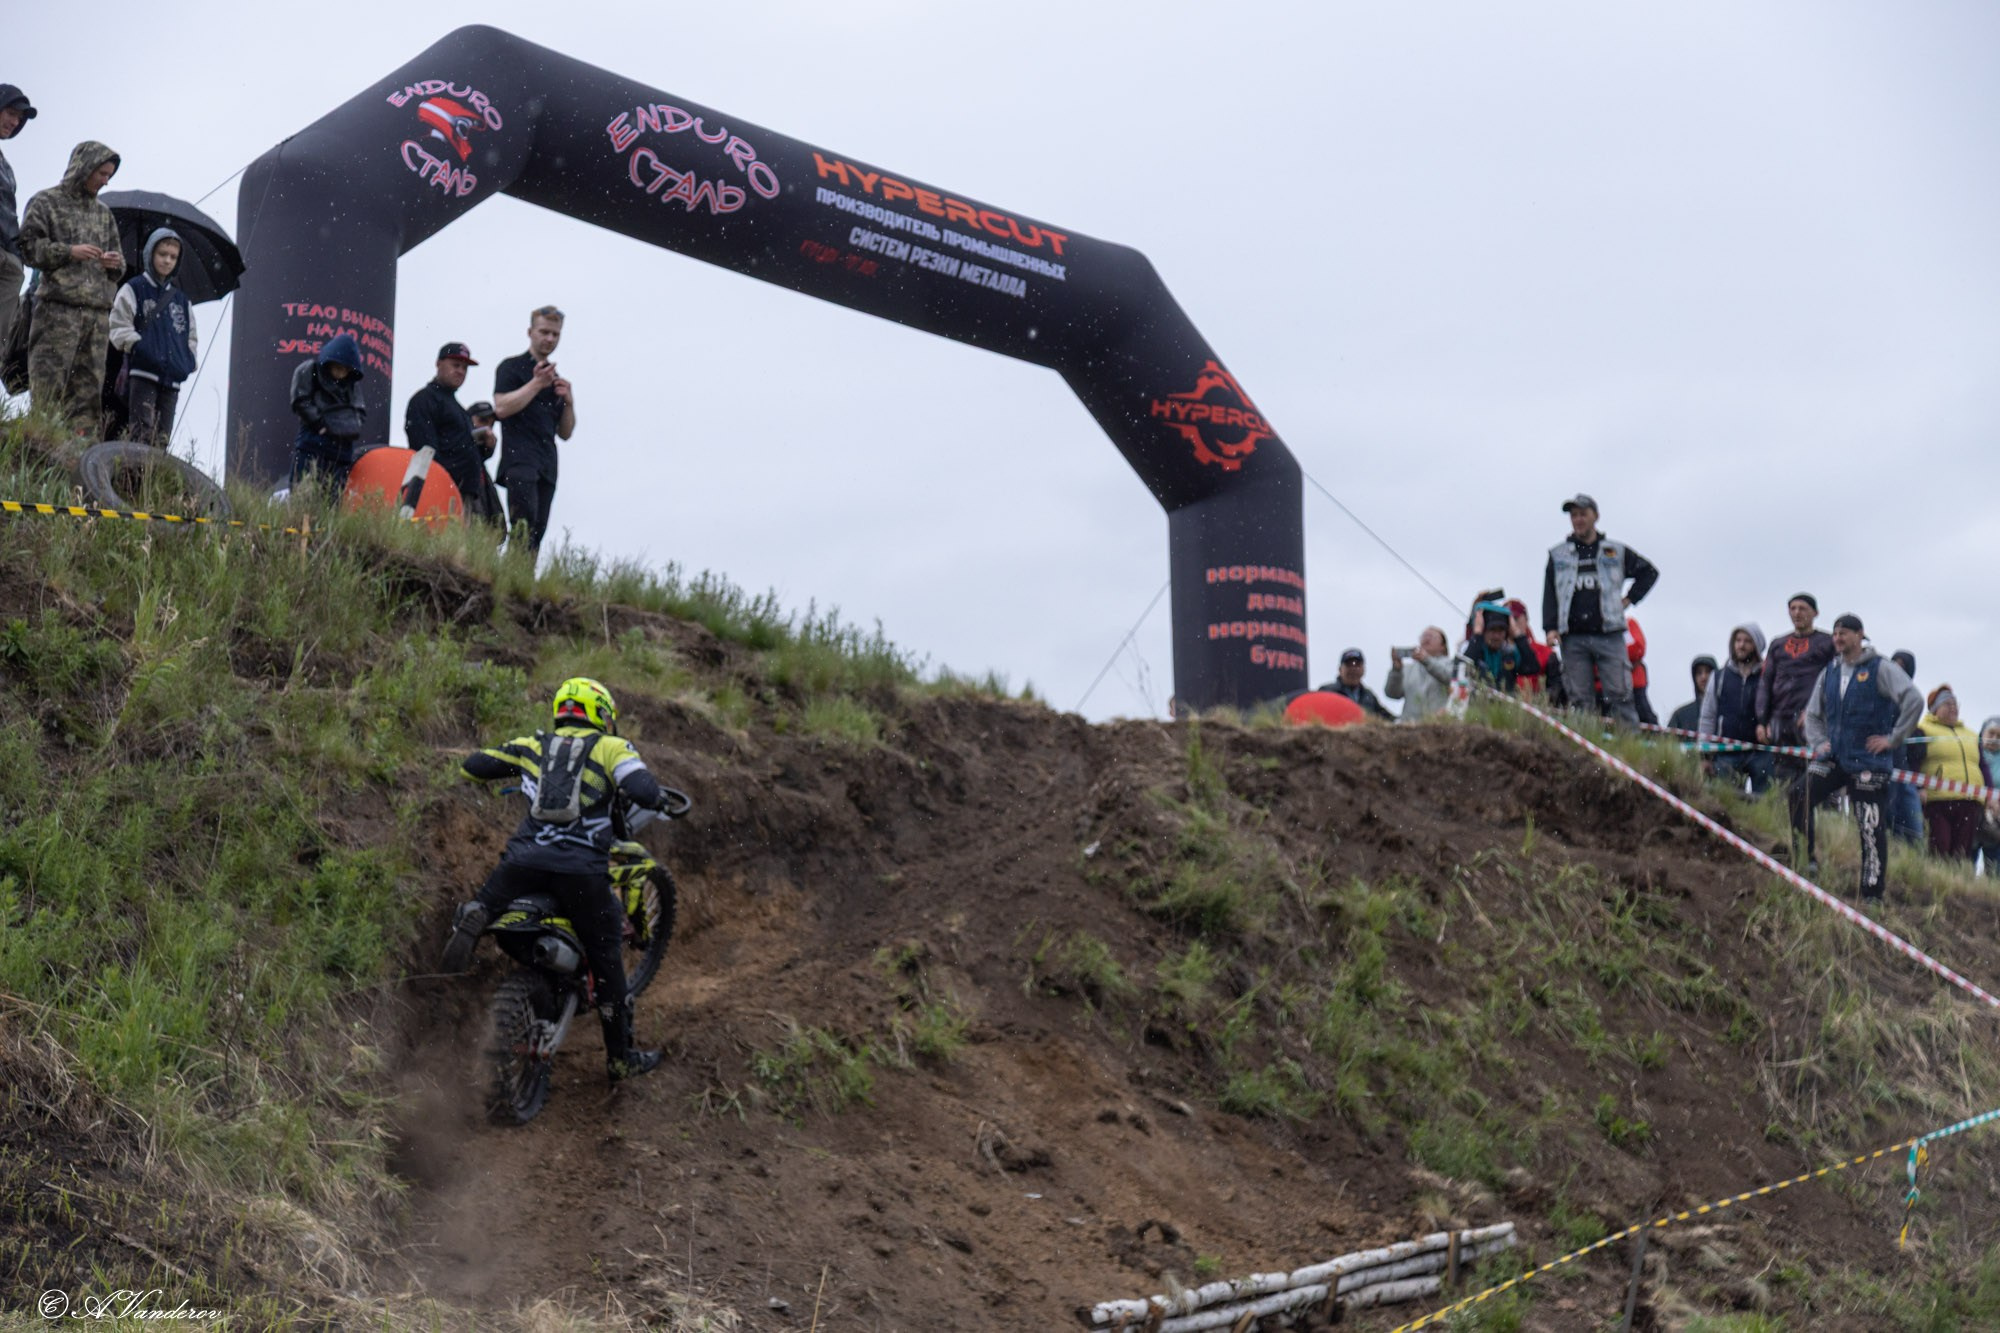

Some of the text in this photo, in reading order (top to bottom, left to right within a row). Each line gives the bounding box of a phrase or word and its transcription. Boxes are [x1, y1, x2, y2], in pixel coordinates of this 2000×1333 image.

[386, 79, 503, 131] ENDURO
[606, 103, 780, 199] ENDURO
[812, 152, 1069, 256] HYPERCUT
[815, 186, 942, 241] ПРОИЗВОДИТЕЛЬ
[941, 228, 1067, 282] ПРОМЫШЛЕННЫХ
[848, 226, 911, 263] СИСТЕМ
[908, 246, 962, 276] РЕЗКИ
[957, 260, 1028, 299] МЕТАЛЛА
[282, 303, 337, 319] ТЕЛО
